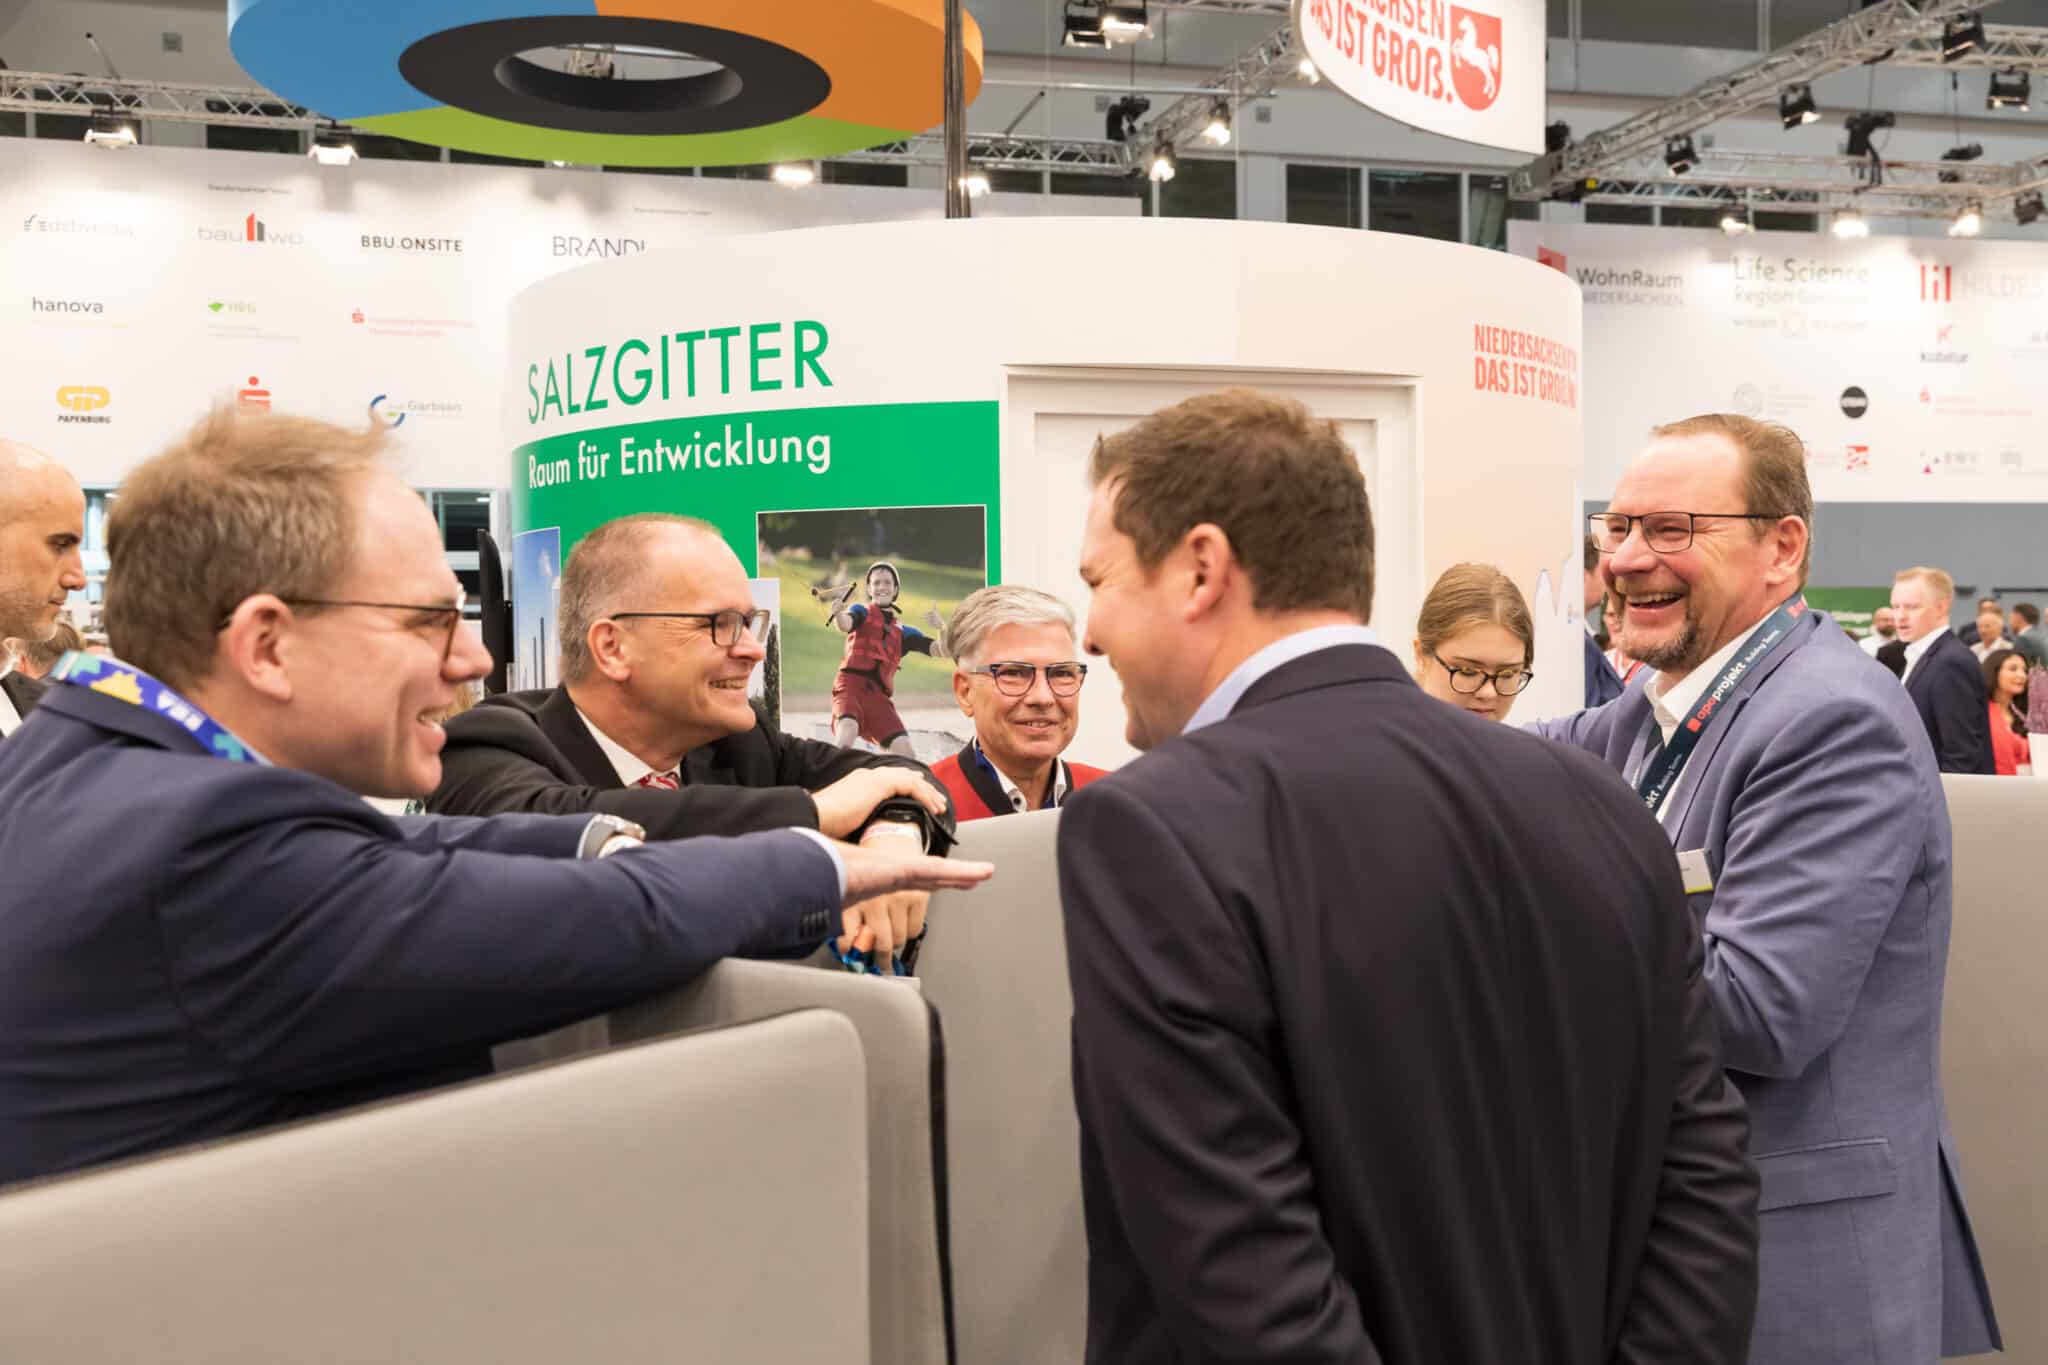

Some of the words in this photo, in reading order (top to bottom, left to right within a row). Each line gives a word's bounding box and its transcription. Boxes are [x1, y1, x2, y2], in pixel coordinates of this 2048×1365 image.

[1335, 0, 1369, 66] IST
[360, 235, 463, 253] BBU.ONSITE
[1575, 267, 1684, 289] WohnRaum
[1733, 256, 1777, 282] Life
[32, 297, 104, 314] hanova
[527, 320, 834, 425] SALZGITTER
[1474, 356, 1510, 393] DAS
[1513, 361, 1537, 398] IST
[57, 414, 112, 425] PAPENBURG
[528, 454, 571, 489] Raum
[578, 440, 611, 481] für
[620, 422, 832, 475] Entwicklung
[1696, 661, 1747, 720] apoprojekt
